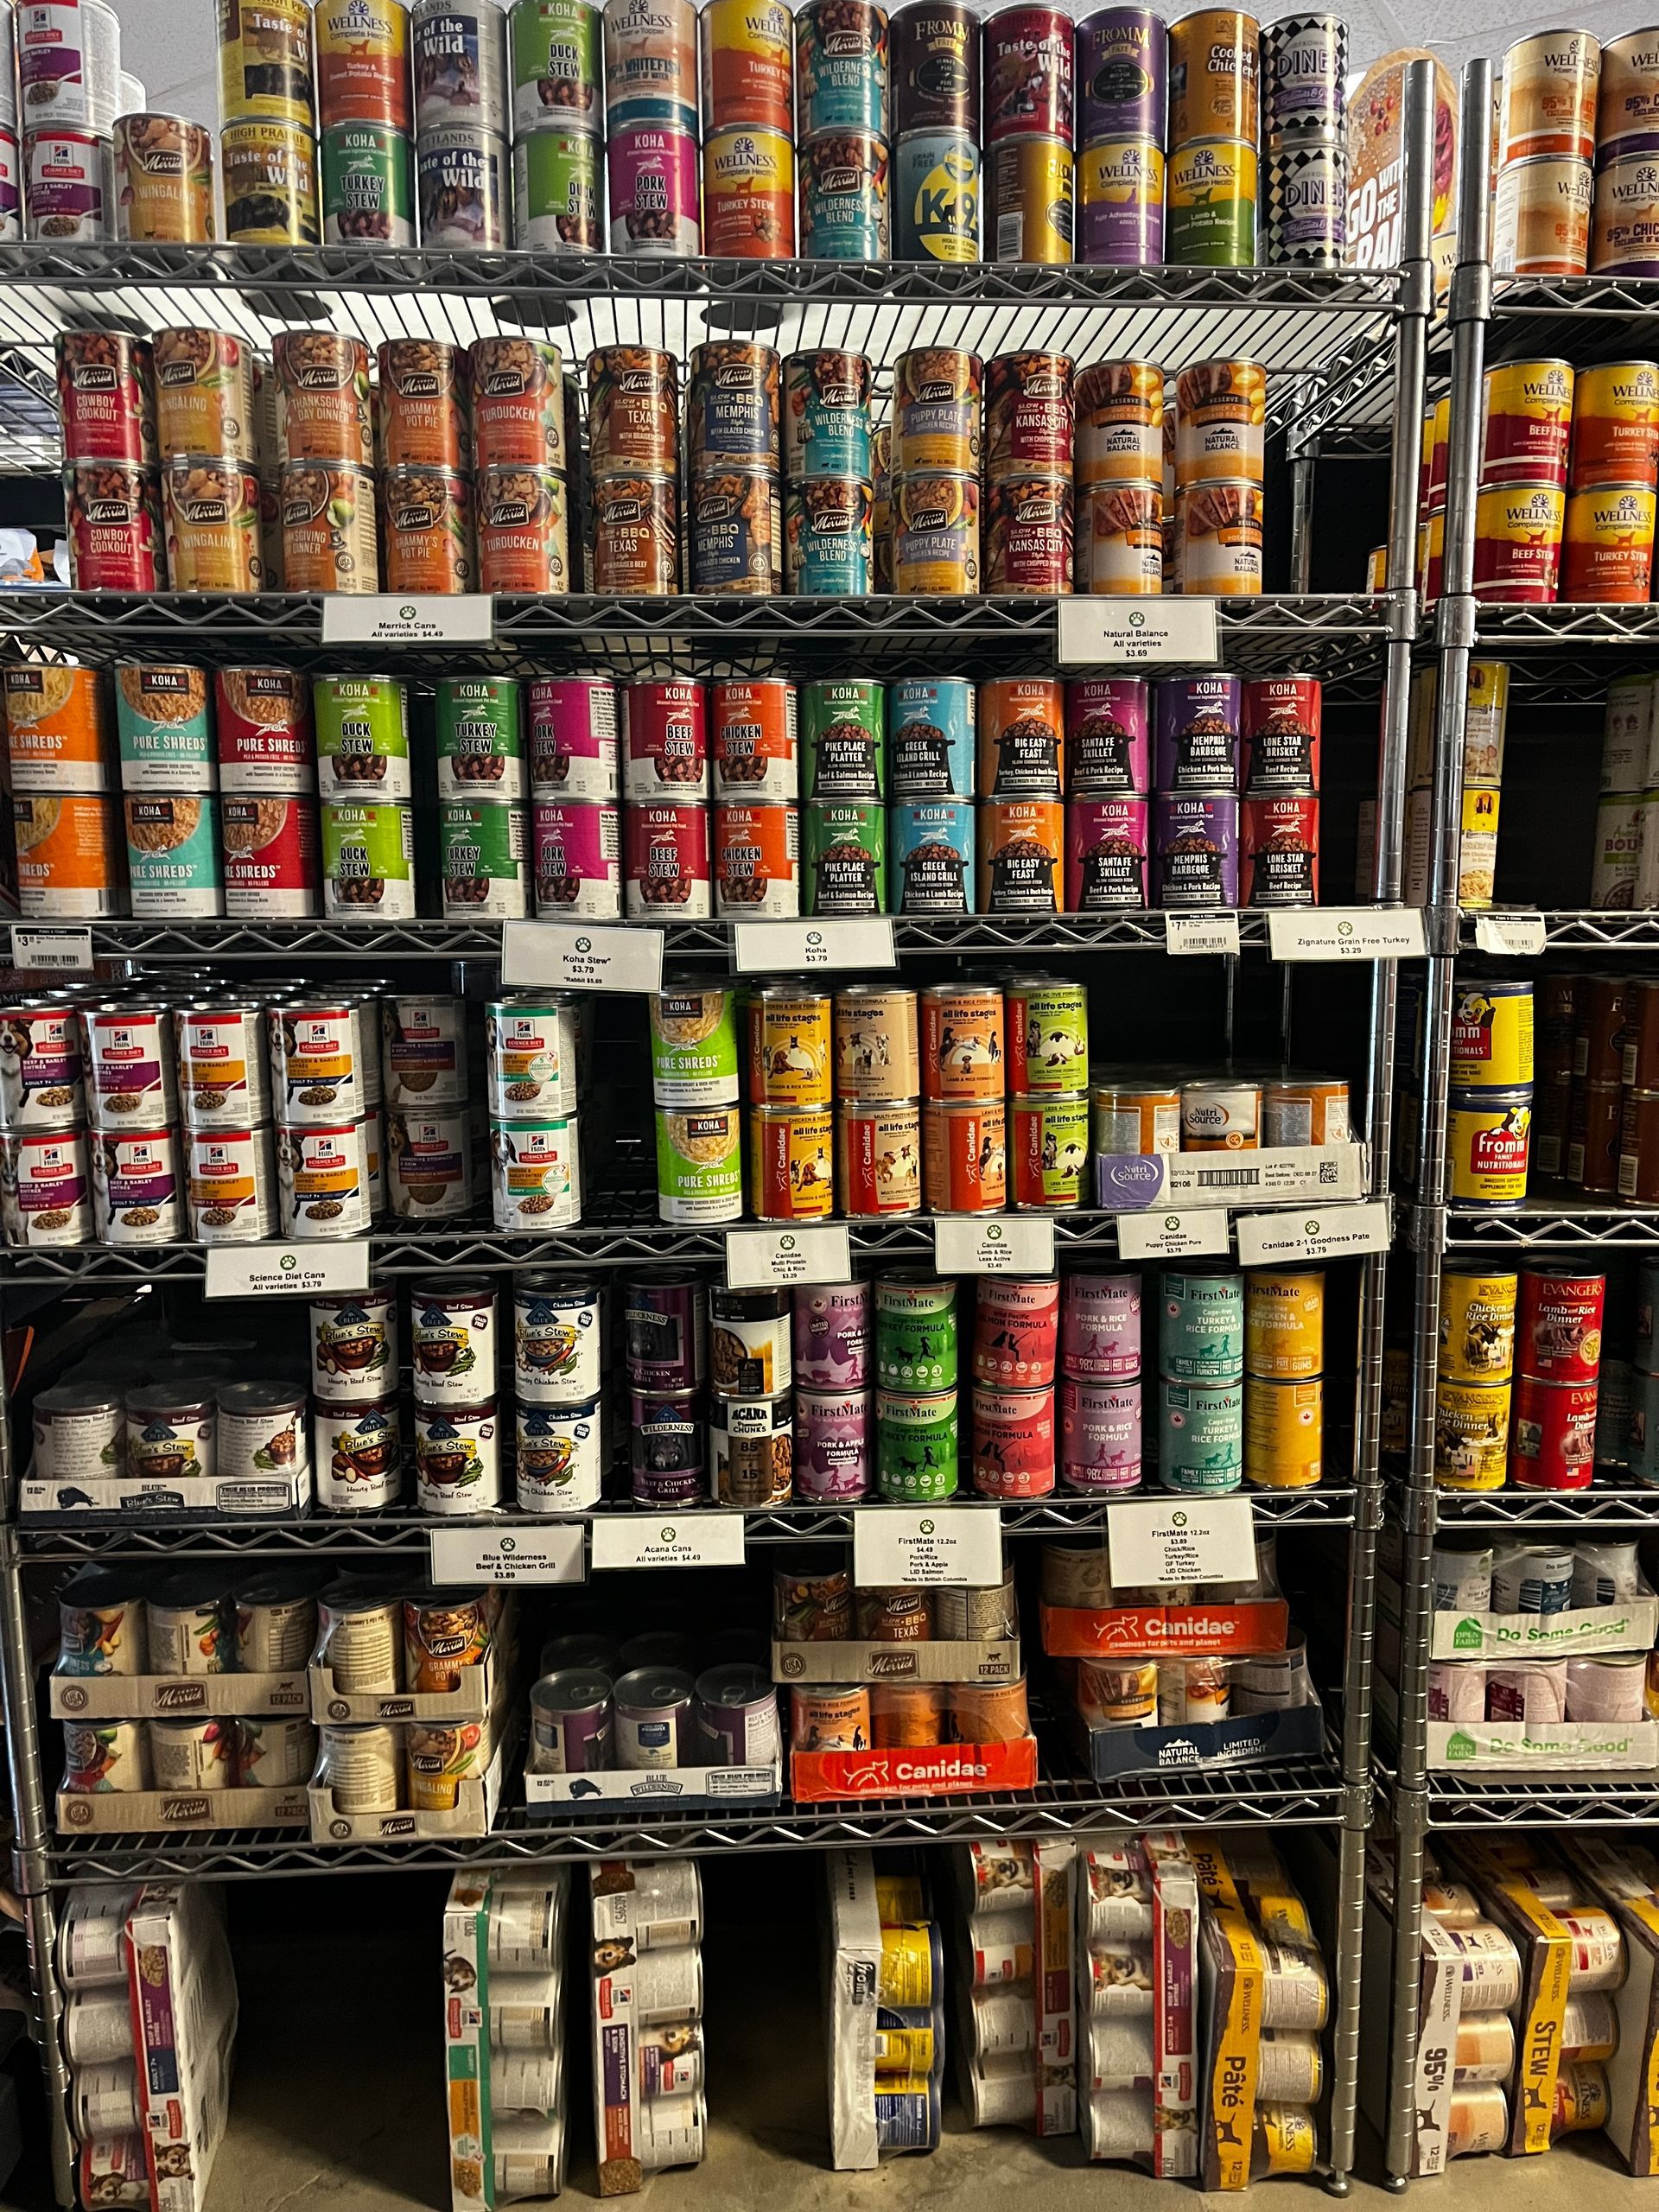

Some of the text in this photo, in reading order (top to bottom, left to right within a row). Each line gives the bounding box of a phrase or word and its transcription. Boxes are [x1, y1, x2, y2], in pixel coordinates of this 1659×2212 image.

[997, 41, 1071, 60] Taste of the
[1038, 54, 1071, 80] Wild
[1276, 49, 1340, 78] DINER
[346, 134, 376, 148] KOHA
[340, 174, 385, 193] TURKEY
[346, 192, 380, 209] STEW
[1377, 183, 1398, 222] THE
[1346, 178, 1377, 244] GO
[715, 405, 760, 419] MEMPHIS
[1107, 436, 1141, 445] NATURAL
[1107, 443, 1141, 453] BALANCE
[90, 528, 130, 542] COWBOY
[90, 541, 132, 555] COOKOUT
[486, 536, 540, 551] TURDUCKEN
[806, 538, 858, 554] WILDERNESS
[1008, 537, 1065, 553] KANSAS CITY
[819, 548, 847, 562] BLEND
[339, 683, 369, 696] KOHA
[341, 722, 371, 736] DUCK
[721, 724, 762, 740] CHICKEN
[133, 735, 206, 751] PURE SHREDS
[341, 738, 373, 753] STEW
[824, 741, 866, 752] PIKE PLACE
[1192, 735, 1225, 746] MEMPHIS
[1263, 735, 1302, 747] LONE STAR
[726, 740, 755, 756] STEW
[1190, 746, 1227, 757] BARBEQUE
[1266, 746, 1299, 757] BRISKET
[830, 752, 862, 762] PLATTER
[922, 861, 947, 872] GREEK
[1007, 859, 1040, 869] BIG EASY
[1098, 856, 1132, 867] SANTA FE
[910, 872, 958, 882] ISLAND GRILL
[1011, 868, 1036, 880] FEAST
[1100, 866, 1131, 877] SKILLET
[1297, 938, 1336, 946] Zignature
[563, 955, 585, 963] Koha
[572, 965, 594, 974] $3.79
[791, 1014, 821, 1023] stages
[1478, 1135, 1525, 1155] fromm
[1123, 1164, 1147, 1173] Nutri
[1477, 1159, 1526, 1170] NUTRITIONALS
[1117, 1171, 1153, 1182] Source
[1262, 1232, 1370, 1250] Canidae 2-1 Goodness Pate
[1306, 1246, 1327, 1255] $3.79
[1074, 1287, 1128, 1299] FirstMate
[1543, 1283, 1603, 1296] EVANGER'S
[1539, 1302, 1567, 1315] Lamb
[1579, 1305, 1596, 1314] Rice
[1075, 1313, 1127, 1323] PORK & RICE
[1547, 1313, 1583, 1324] Dinner
[323, 1325, 383, 1341] Blue's Stew
[1080, 1322, 1122, 1332] FORMULA
[732, 1408, 767, 1421] ACANA
[642, 1423, 693, 1434] WILDERNESS
[1152, 1529, 1188, 1538] FirstMate
[1145, 1618, 1236, 1637] Canidae
[1497, 1618, 1626, 1642] Do Some Good
[1109, 1640, 1147, 1649] goodness
[1195, 1638, 1221, 1648] planet
[865, 1656, 913, 1675] Merrick
[979, 1664, 1010, 1674] 12 PACK
[1223, 1738, 1261, 1751] LIMITED
[1158, 1745, 1199, 1758] NATURAL
[1217, 1745, 1267, 1758] INGREDIENT
[1159, 1754, 1201, 1766] BALANCE
[1531, 2020, 1557, 2076] STEW
[1424, 2047, 1448, 2092] 95%
[1221, 2056, 1247, 2108] Pâté
